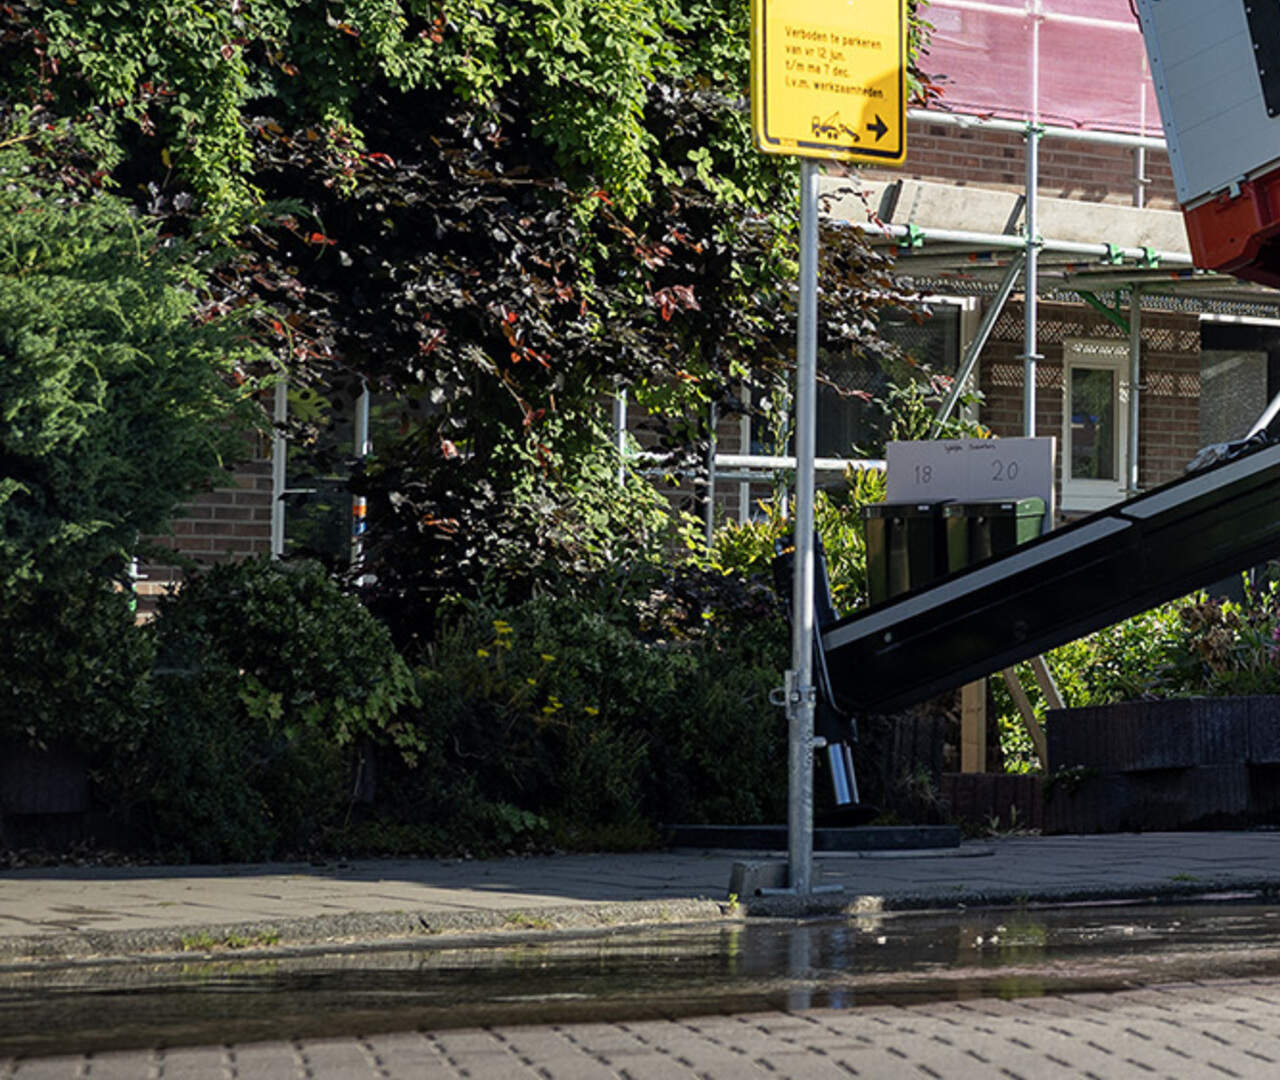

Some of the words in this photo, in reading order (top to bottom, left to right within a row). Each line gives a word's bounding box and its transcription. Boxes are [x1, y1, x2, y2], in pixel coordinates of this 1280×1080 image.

[785, 25, 828, 42] Verboden
[830, 32, 840, 44] te
[842, 35, 882, 49] parkeren
[785, 45, 802, 55] van
[914, 465, 932, 485] 18
[992, 459, 1018, 482] 20
